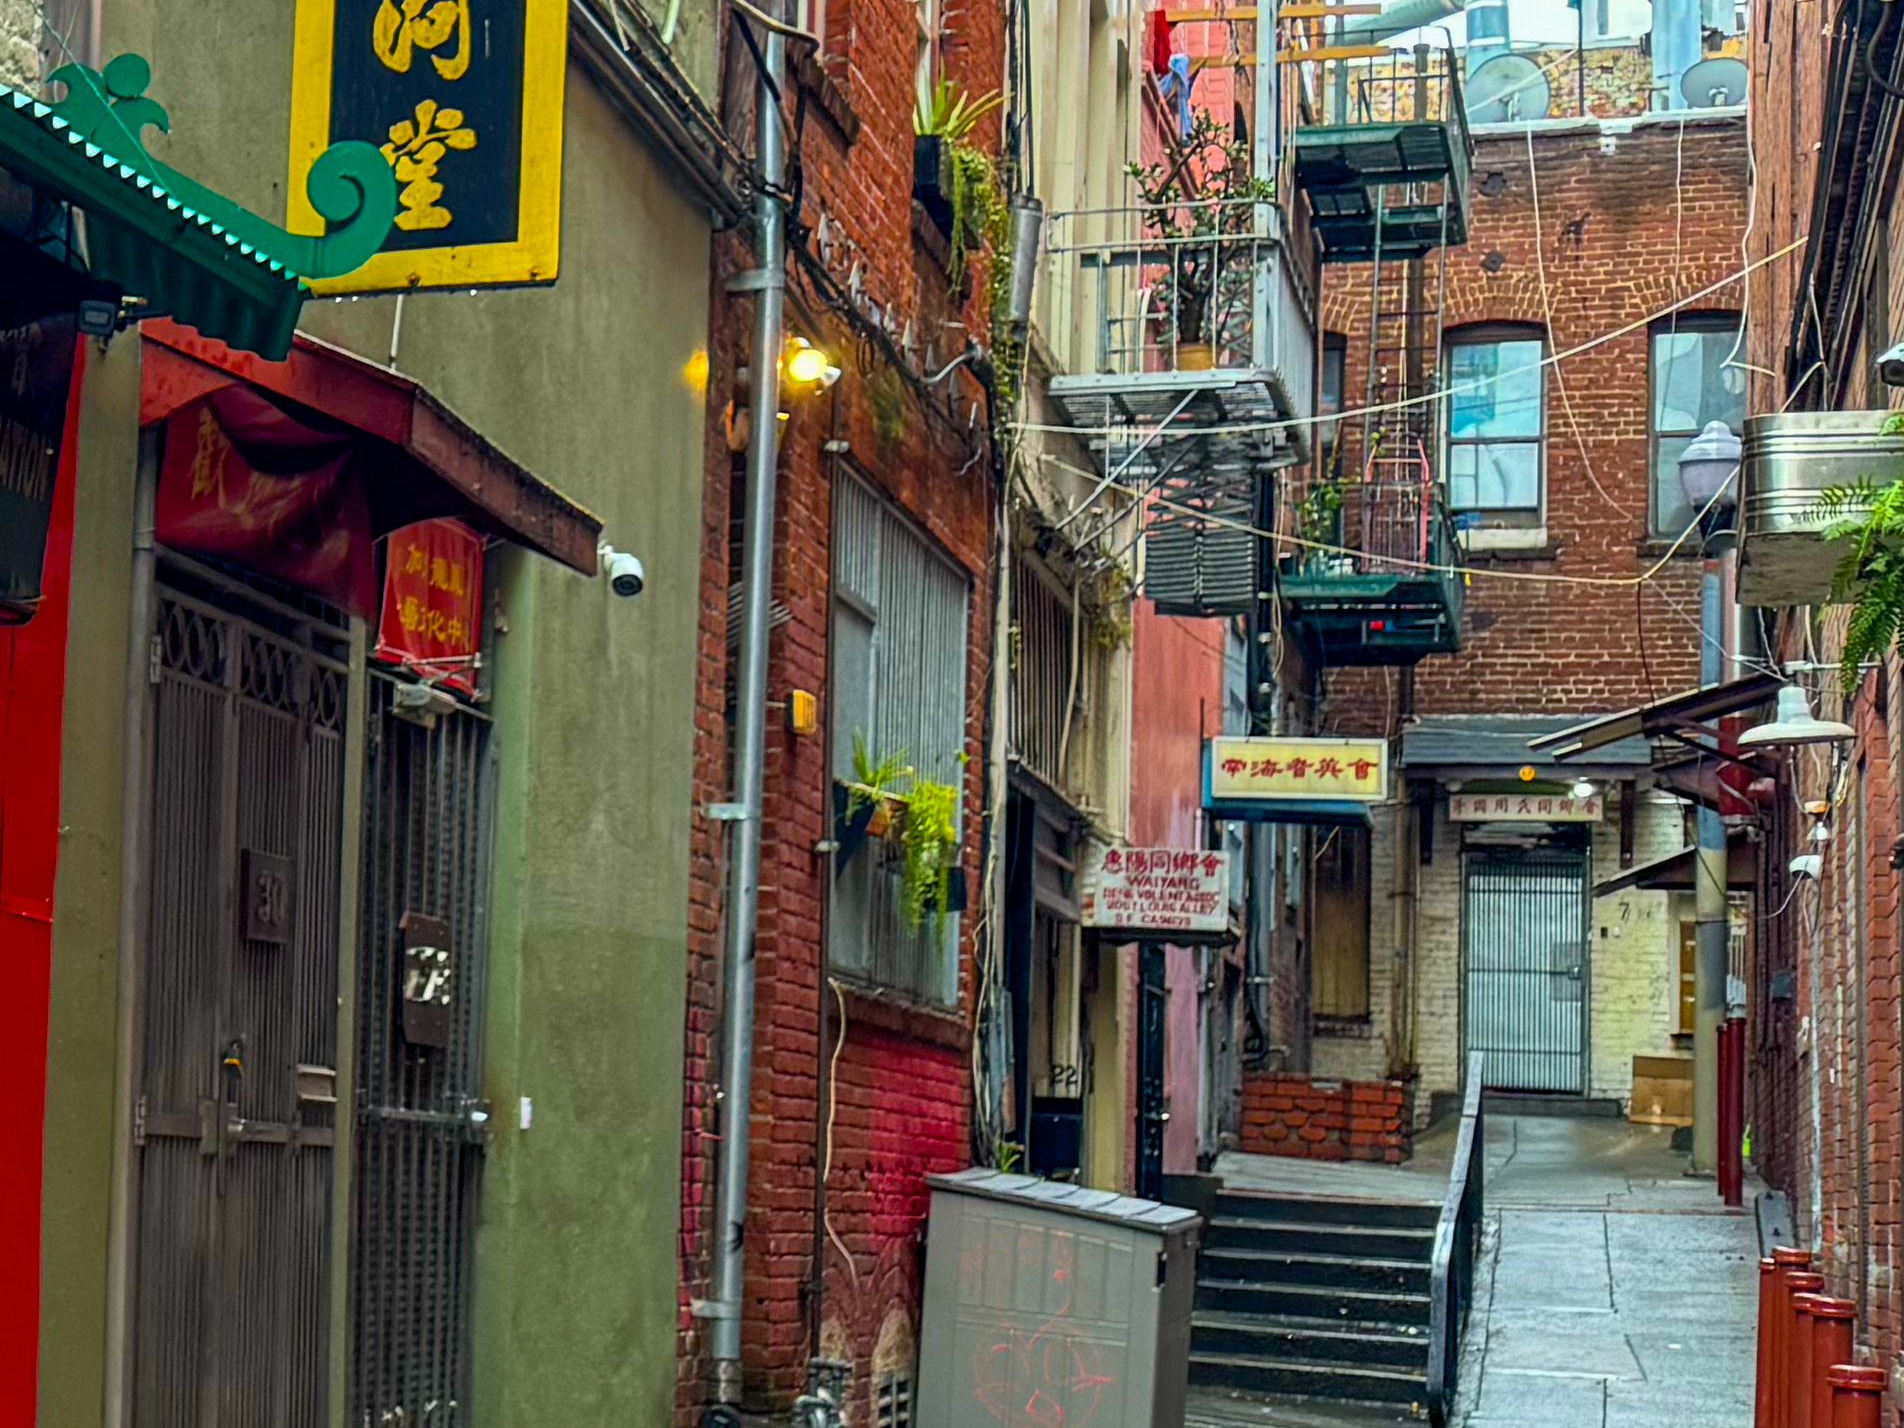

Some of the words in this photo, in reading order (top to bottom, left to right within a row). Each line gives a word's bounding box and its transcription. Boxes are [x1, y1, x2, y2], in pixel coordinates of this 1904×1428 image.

[1101, 849, 1224, 877] 惠陽同鄉會
[1127, 875, 1200, 890] WAIYANG
[1051, 1064, 1078, 1085] 22
